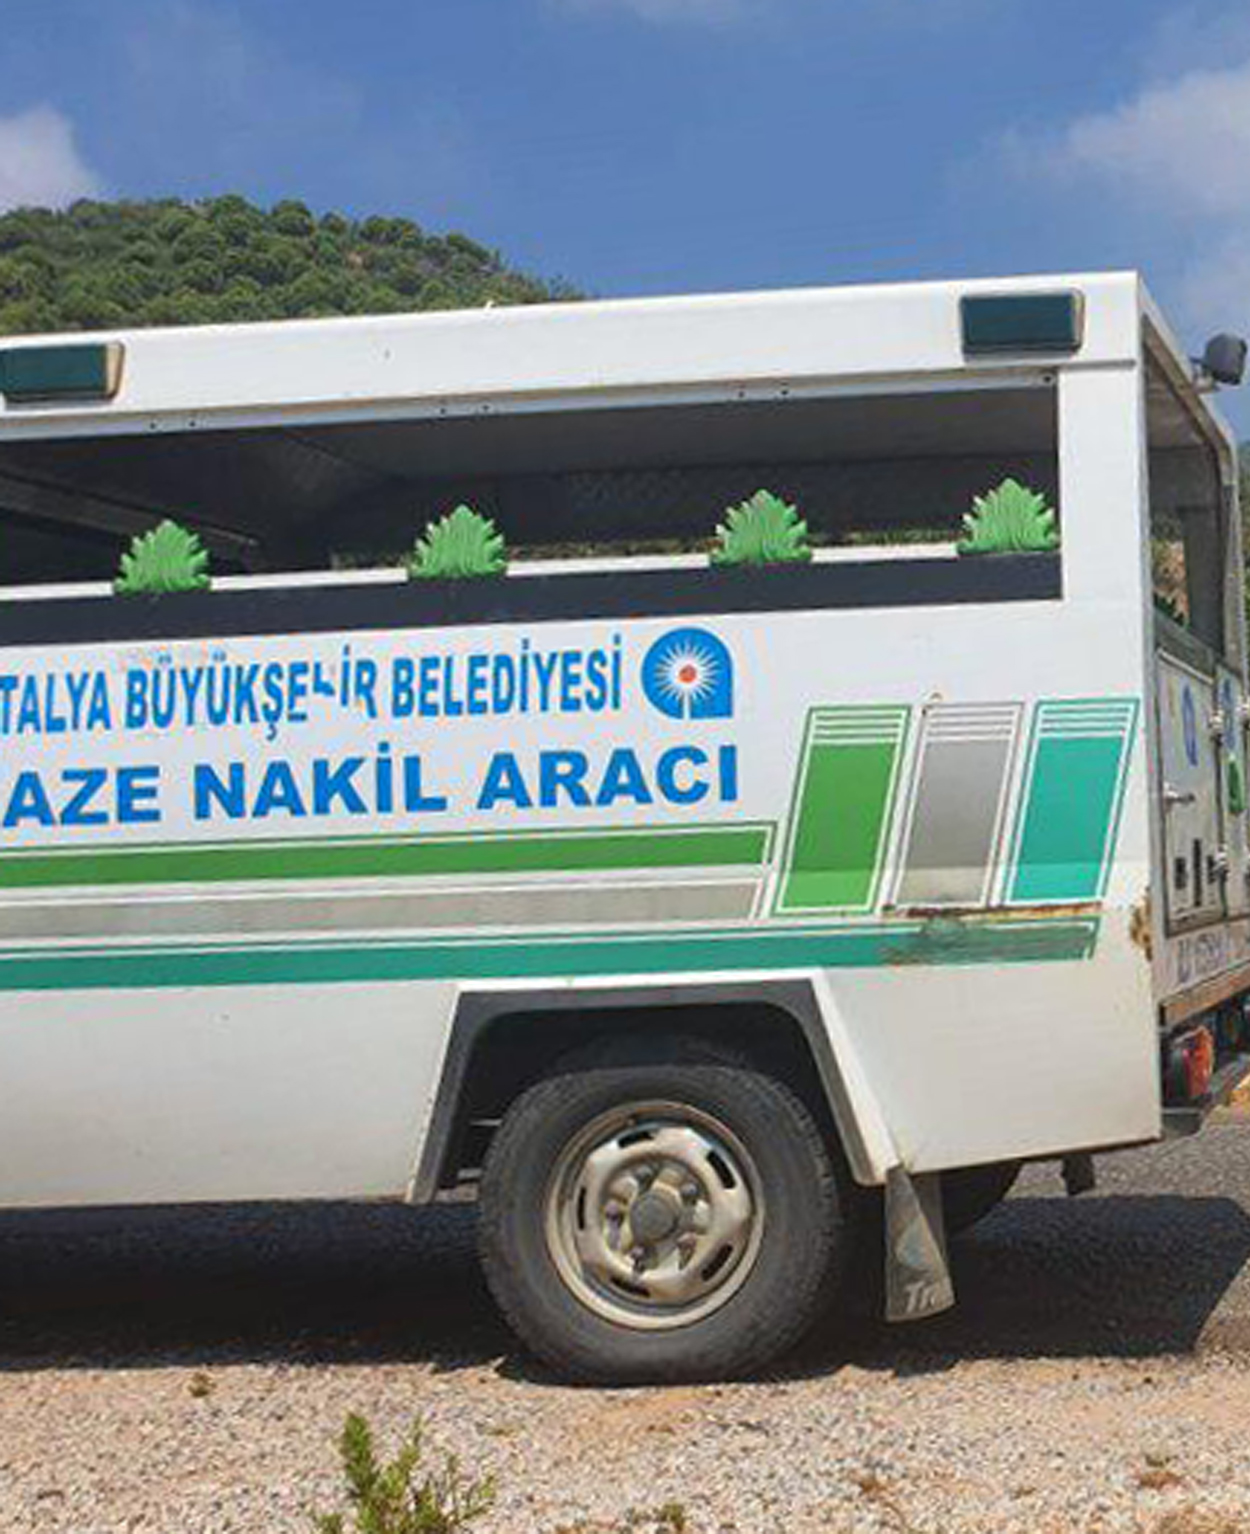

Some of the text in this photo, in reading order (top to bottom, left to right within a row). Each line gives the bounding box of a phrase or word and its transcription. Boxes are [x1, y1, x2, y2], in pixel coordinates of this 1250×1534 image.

[0, 671, 112, 735] TALYA
[391, 632, 622, 719] BELEDİYESİ
[1, 741, 738, 827] AZE NAKİL ARACI
